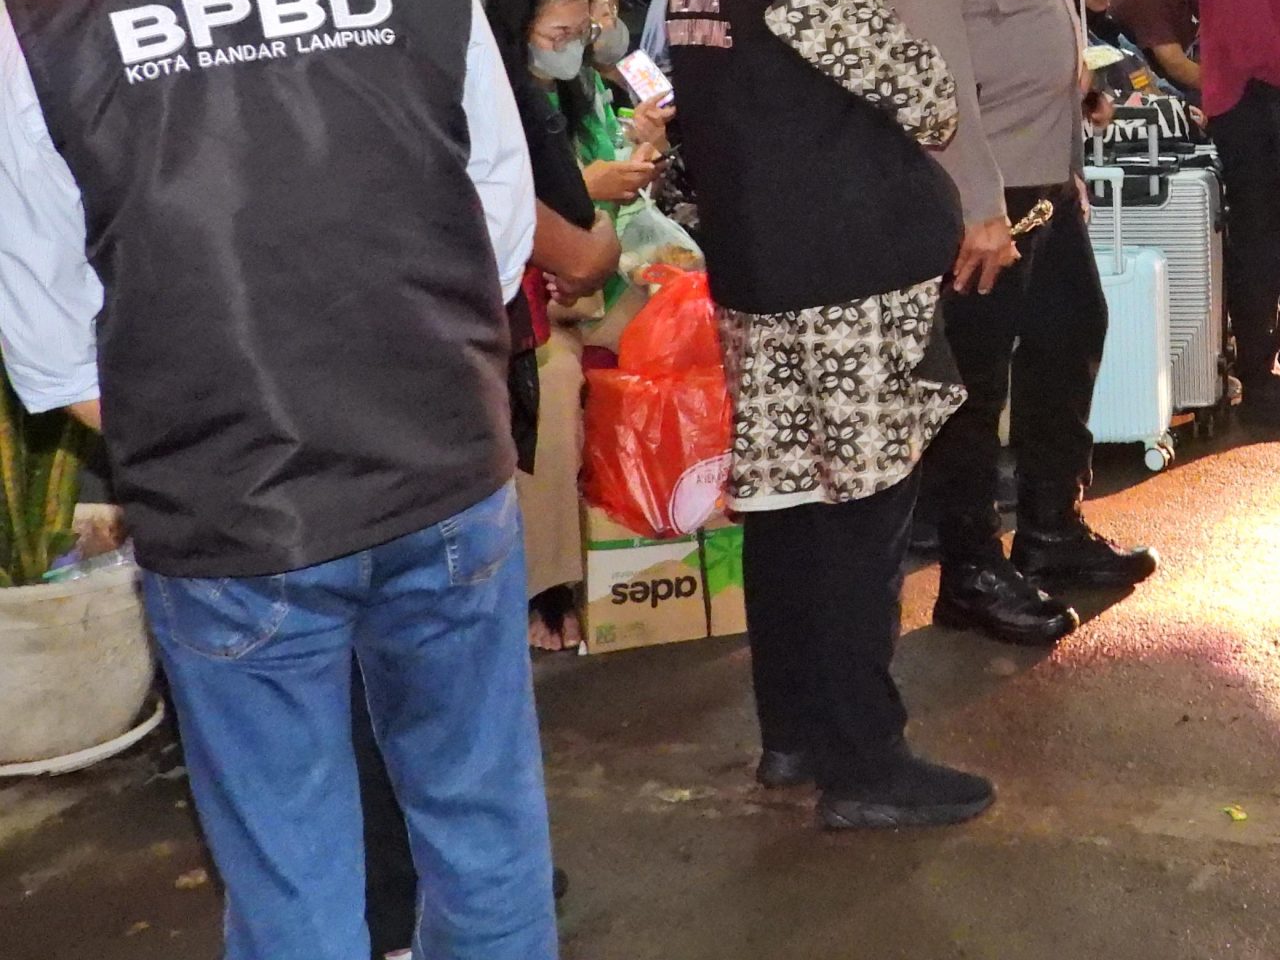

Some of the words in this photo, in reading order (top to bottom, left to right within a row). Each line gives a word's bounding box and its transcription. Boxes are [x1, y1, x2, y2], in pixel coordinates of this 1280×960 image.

[126, 54, 190, 84] KOTA
[198, 41, 286, 68] BANDAR
[296, 28, 396, 53] LAMPUNG
[611, 575, 697, 608] ades
